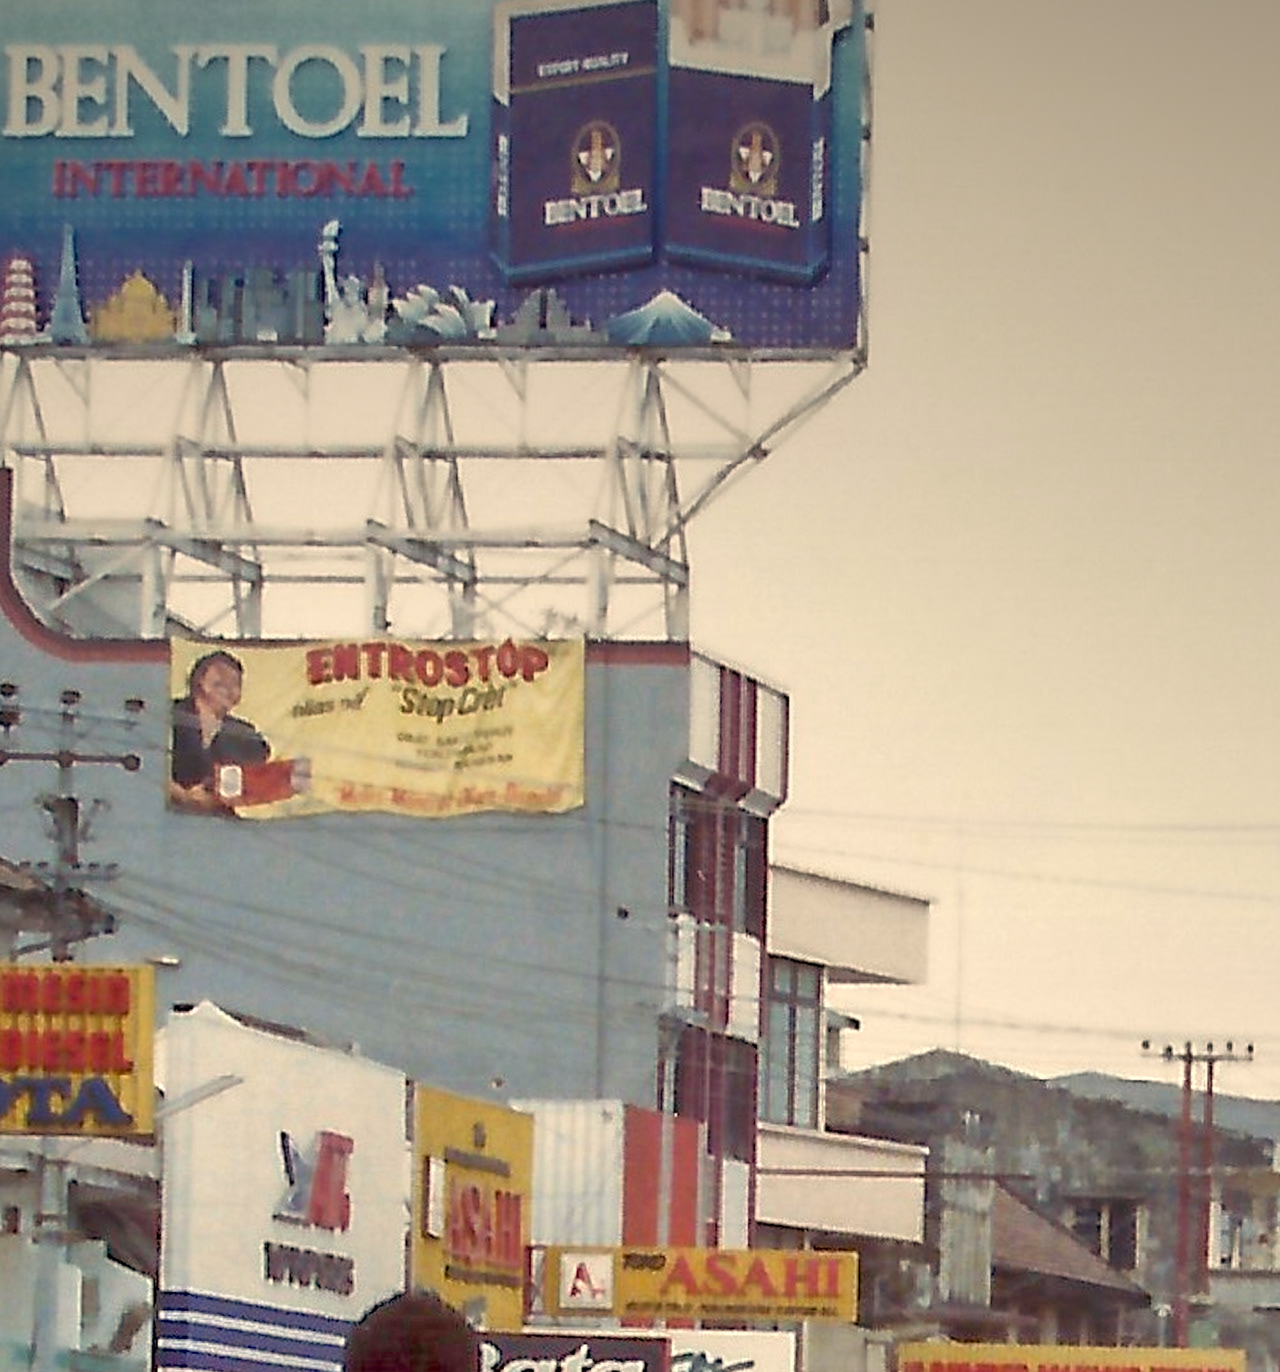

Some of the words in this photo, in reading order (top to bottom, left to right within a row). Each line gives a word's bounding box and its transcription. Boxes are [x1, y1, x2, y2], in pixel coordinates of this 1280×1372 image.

[3, 43, 467, 141] BENTOEL
[52, 159, 415, 201] INTERNATIONAL
[544, 187, 647, 226] BENTOEL
[700, 186, 800, 228] BENTOEL
[306, 638, 549, 688] ENTROSTOP
[660, 1254, 841, 1299] ASAHI
